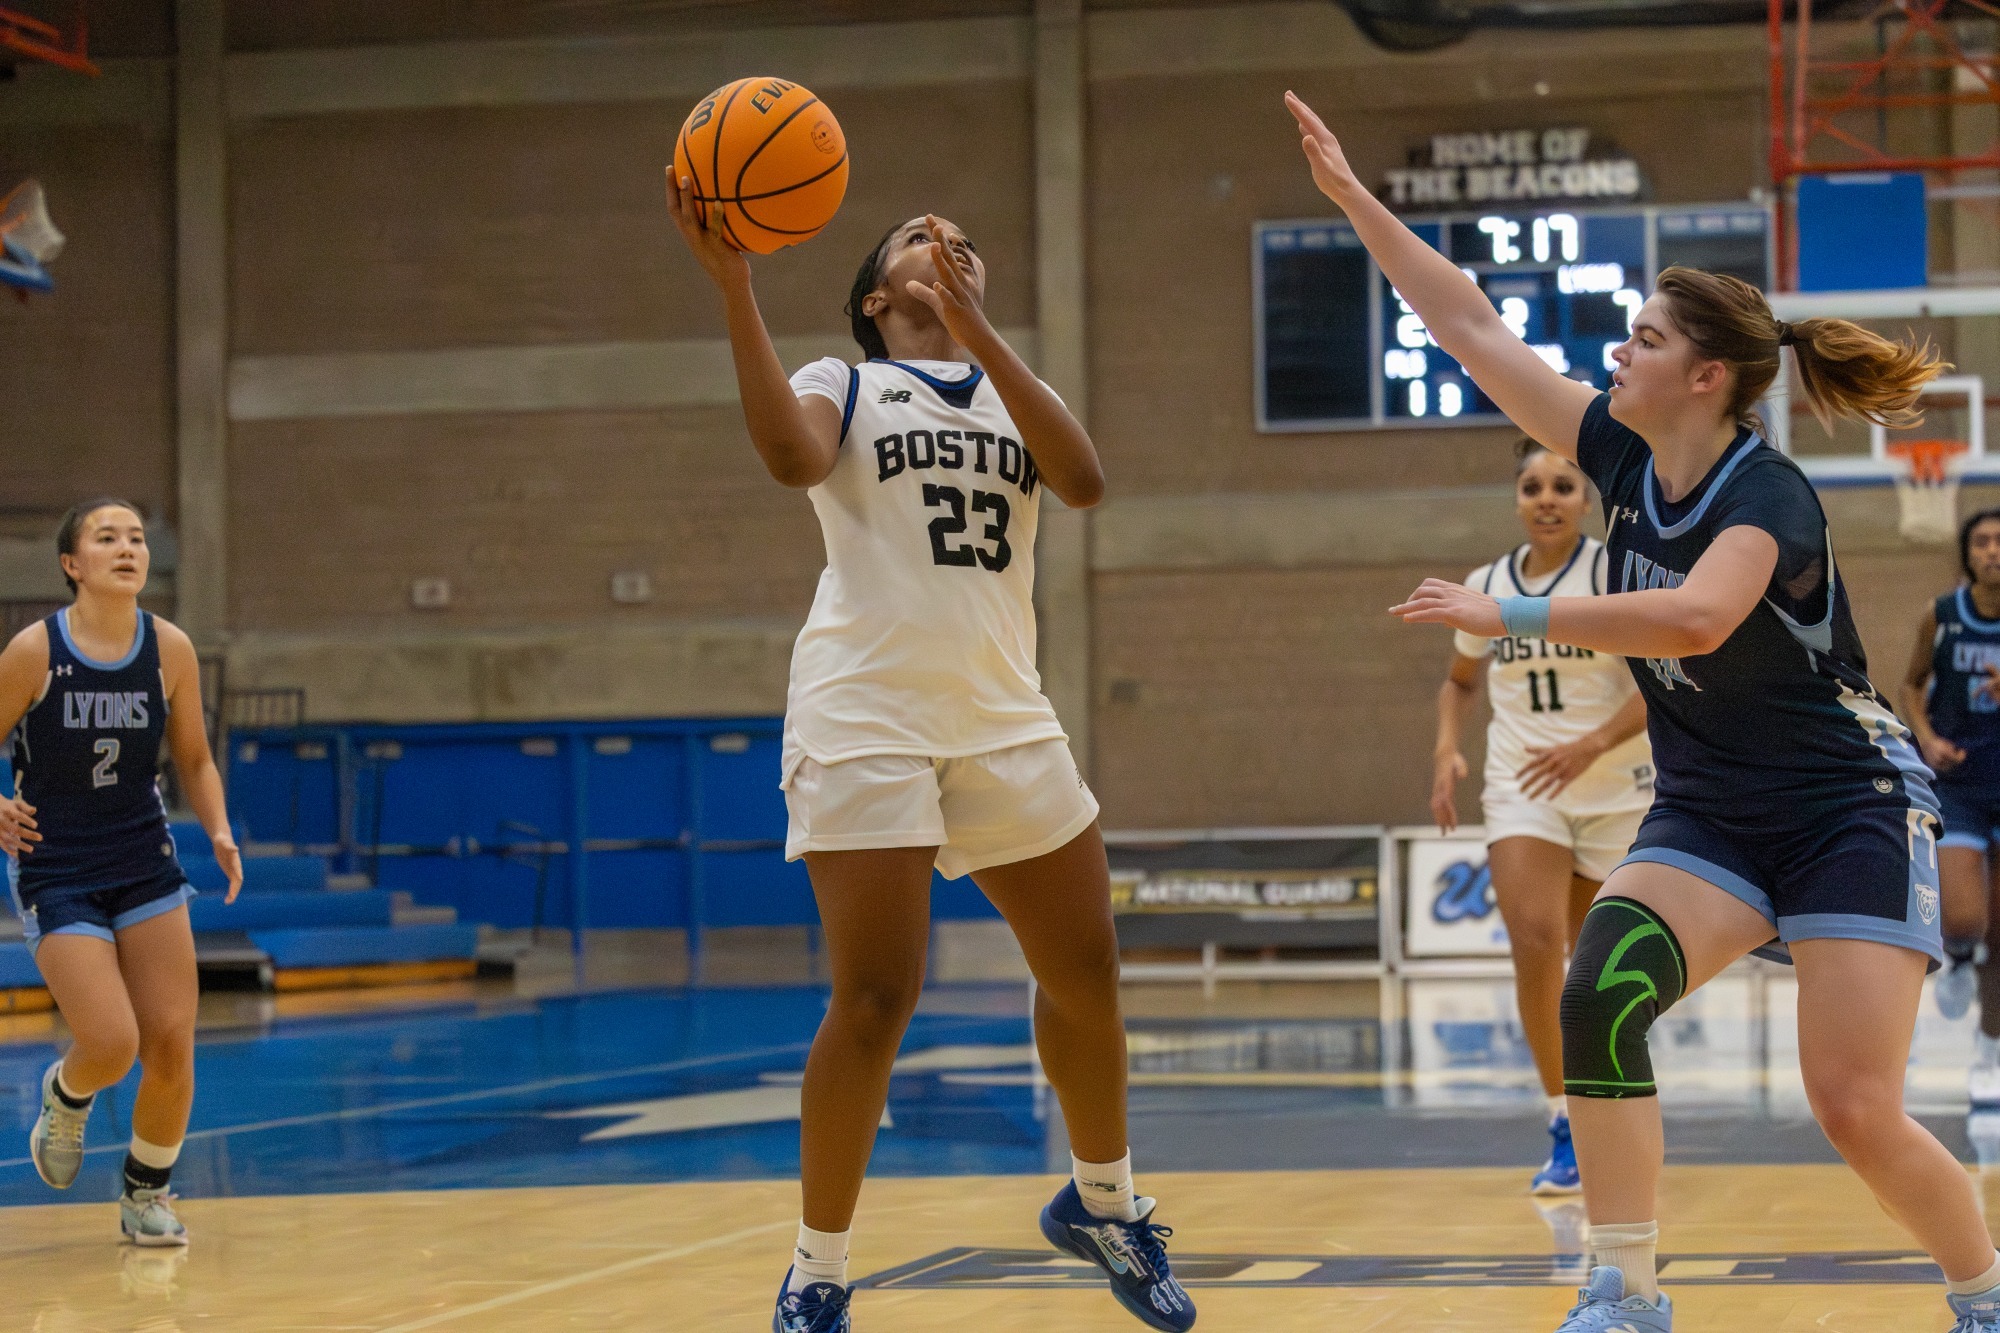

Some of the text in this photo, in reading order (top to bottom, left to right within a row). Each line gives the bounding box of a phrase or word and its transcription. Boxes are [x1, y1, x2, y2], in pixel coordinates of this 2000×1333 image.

[1431, 130, 1590, 164] HOME OF
[1386, 160, 1640, 200] THE BEACONS
[1478, 213, 1579, 264] 7:17
[922, 483, 1012, 573] 23
[64, 691, 149, 729] LYONS
[1526, 668, 1564, 713] 11
[92, 737, 120, 789] 2
